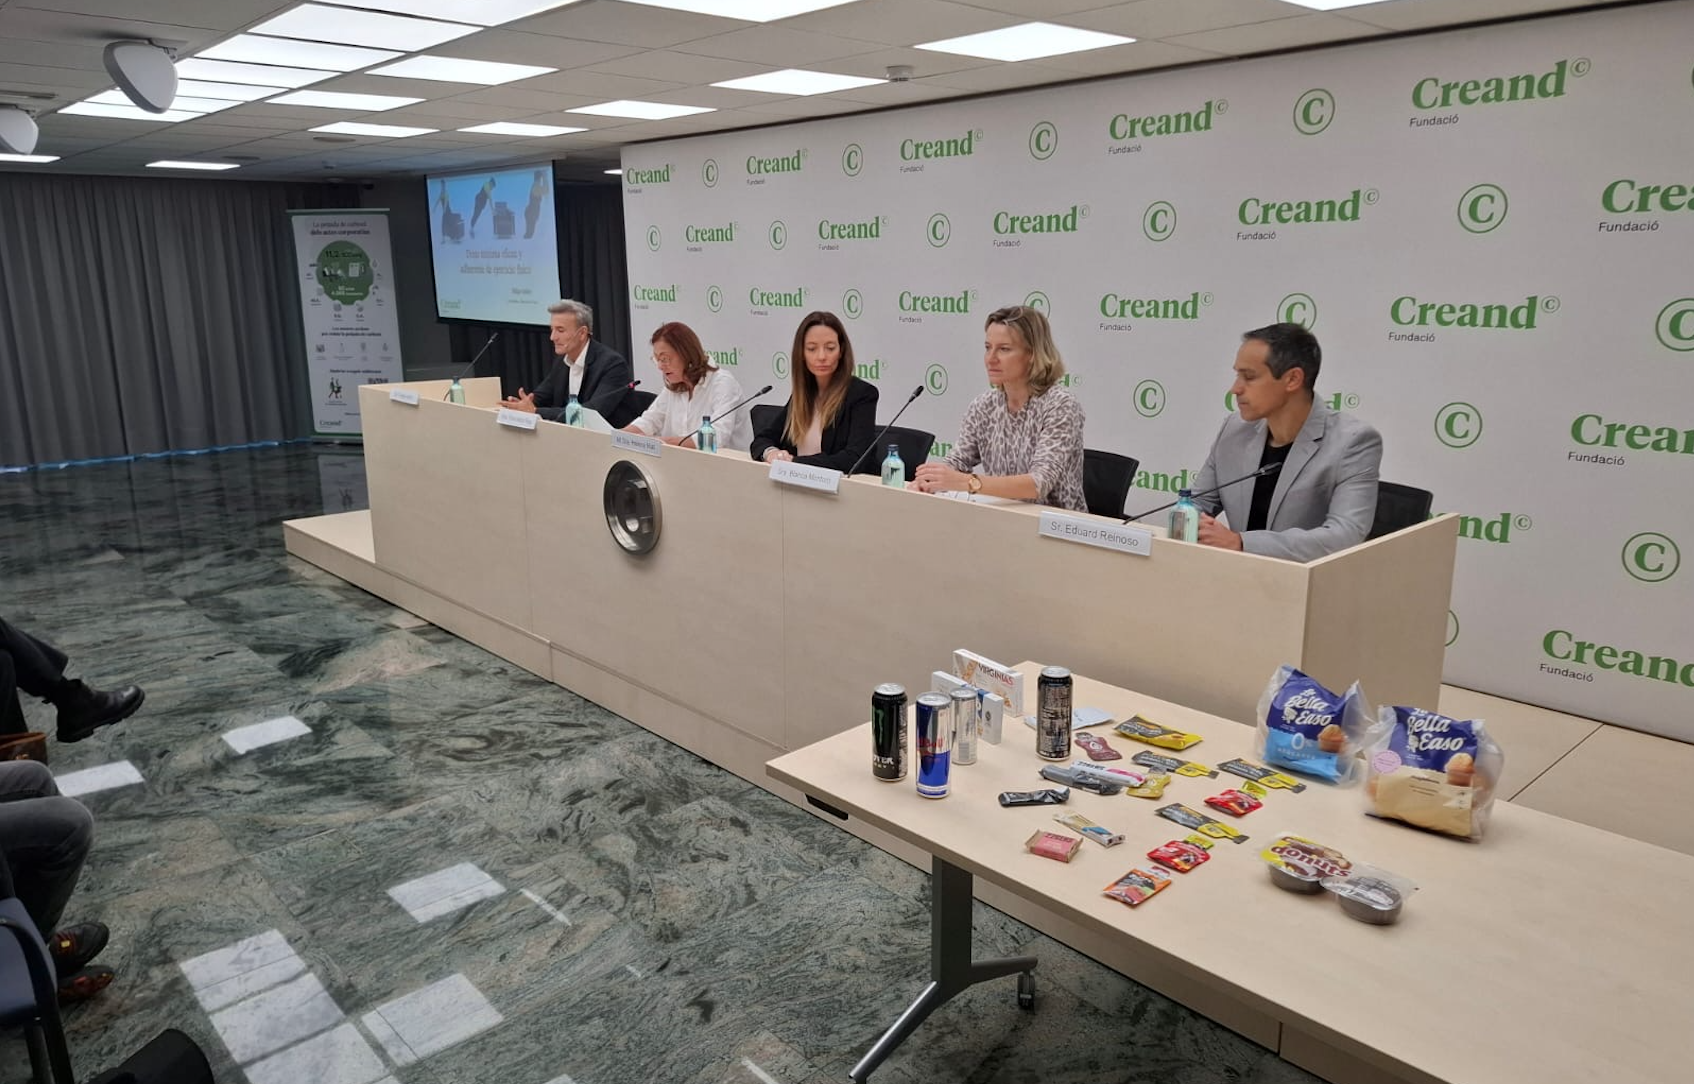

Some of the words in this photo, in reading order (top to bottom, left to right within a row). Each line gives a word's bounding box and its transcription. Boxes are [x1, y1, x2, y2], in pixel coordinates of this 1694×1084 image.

[1409, 114, 1459, 127] Fundació
[1108, 144, 1142, 155] Fundació
[1598, 220, 1660, 232] Fundació
[1236, 231, 1277, 241] Fundació
[1100, 323, 1132, 332] Fundació
[1388, 331, 1436, 342] Fundació
[1568, 451, 1625, 465] Fundació
[1050, 520, 1063, 532] Sr.
[1065, 524, 1097, 539] Eduard
[1100, 530, 1139, 547] Reinoso
[978, 663, 1014, 686] VIRGINIAS
[1539, 663, 1594, 682] Fundació
[1284, 695, 1330, 711] Bella
[1295, 710, 1332, 726] Easo
[1419, 733, 1464, 751] Easo
[1271, 845, 1351, 878] donuts
